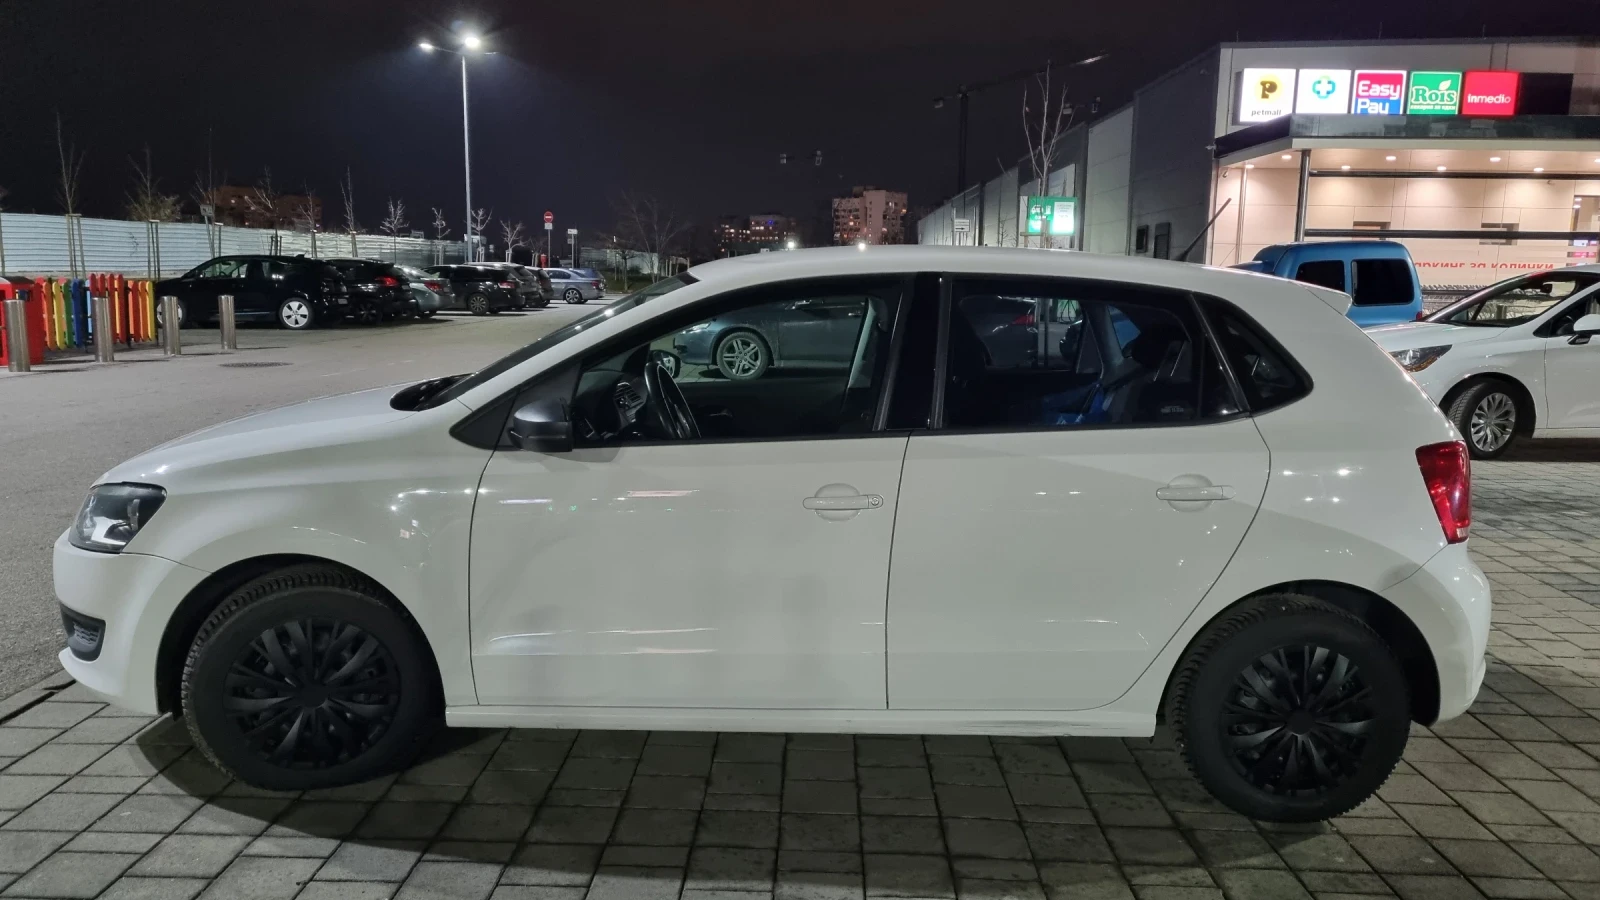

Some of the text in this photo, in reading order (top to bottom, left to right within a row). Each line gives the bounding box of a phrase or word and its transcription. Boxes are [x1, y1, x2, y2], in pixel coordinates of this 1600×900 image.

[1358, 80, 1401, 100] Easy
[1411, 85, 1457, 104] Rois
[1467, 93, 1511, 104] inmedio
[1251, 109, 1282, 117] petmall
[1357, 98, 1390, 115] Pay
